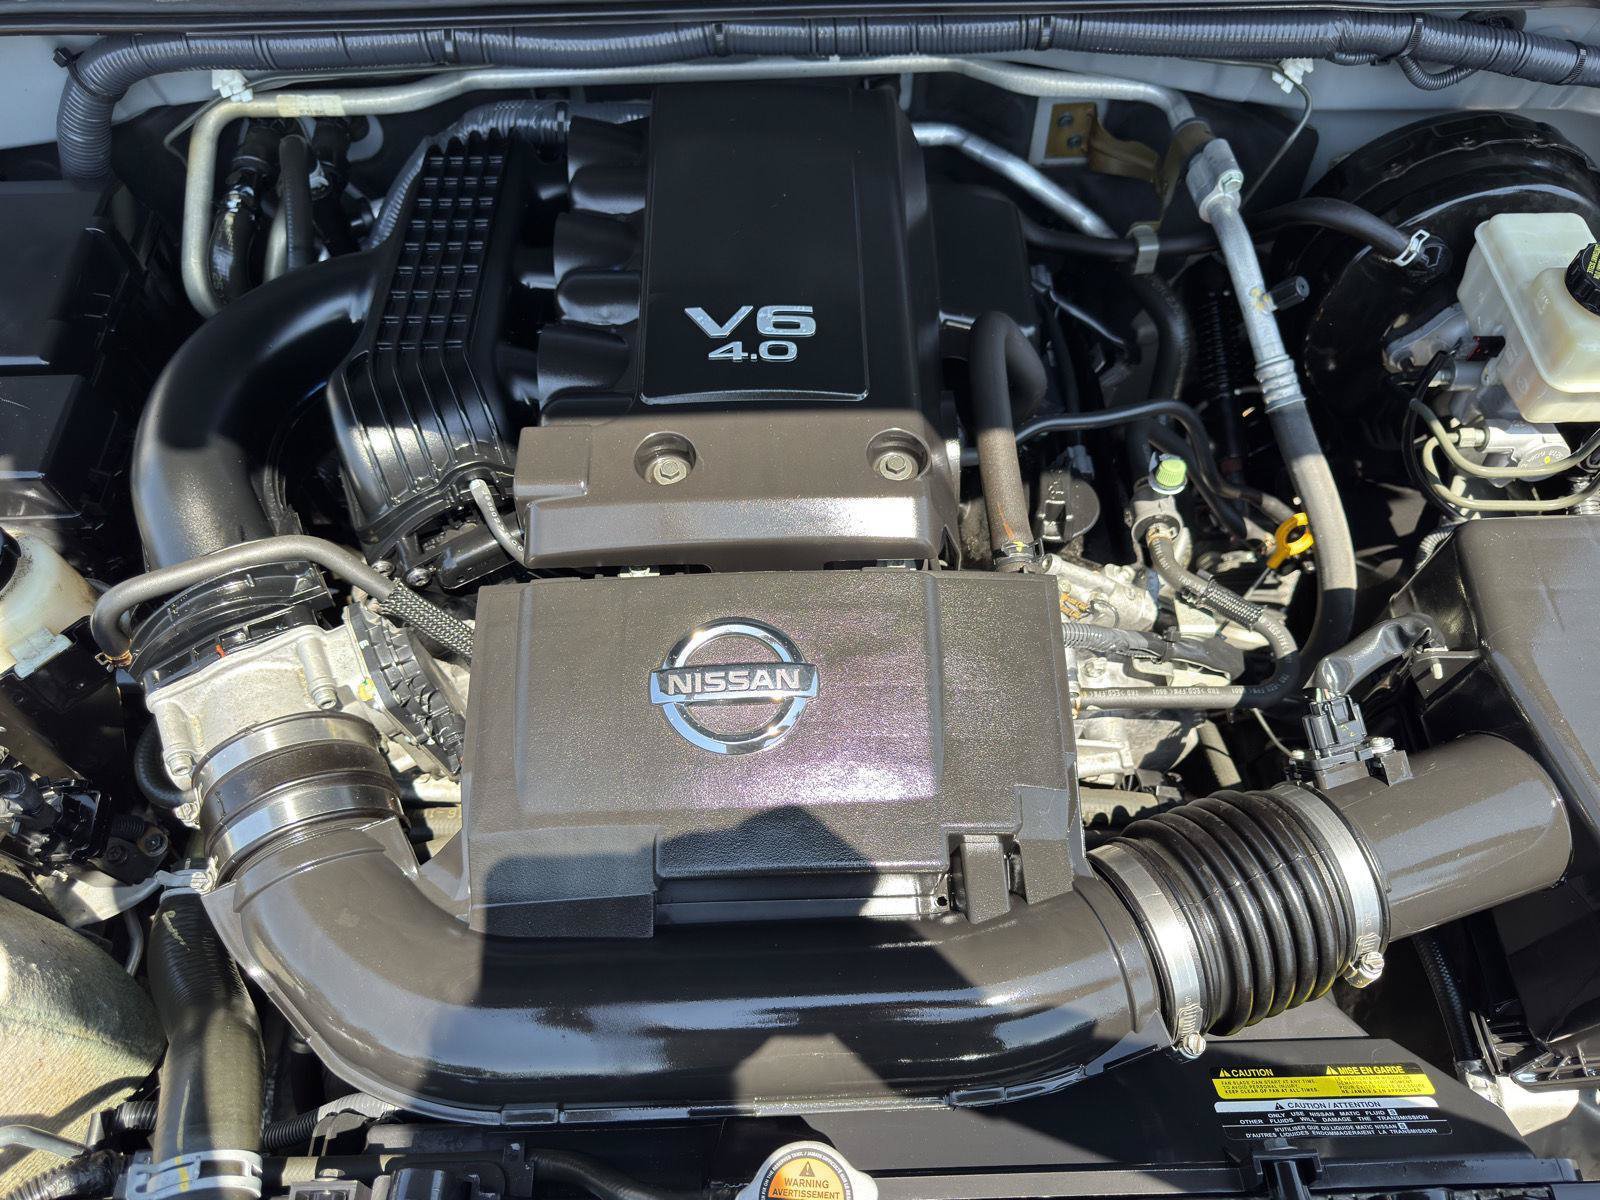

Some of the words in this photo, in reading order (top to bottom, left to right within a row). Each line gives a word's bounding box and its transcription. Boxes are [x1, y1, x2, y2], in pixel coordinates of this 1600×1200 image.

[684, 305, 816, 338] V6
[708, 340, 798, 362] 4.0
[668, 668, 800, 695] NISSAN
[1231, 1068, 1274, 1078] CAUTION
[1338, 1066, 1360, 1075] MISE
[1360, 1066, 1374, 1075] EN
[1373, 1065, 1406, 1074] GARDE
[784, 1177, 830, 1189] WARNING
[772, 1188, 840, 1200] AVERTISSEMENT
